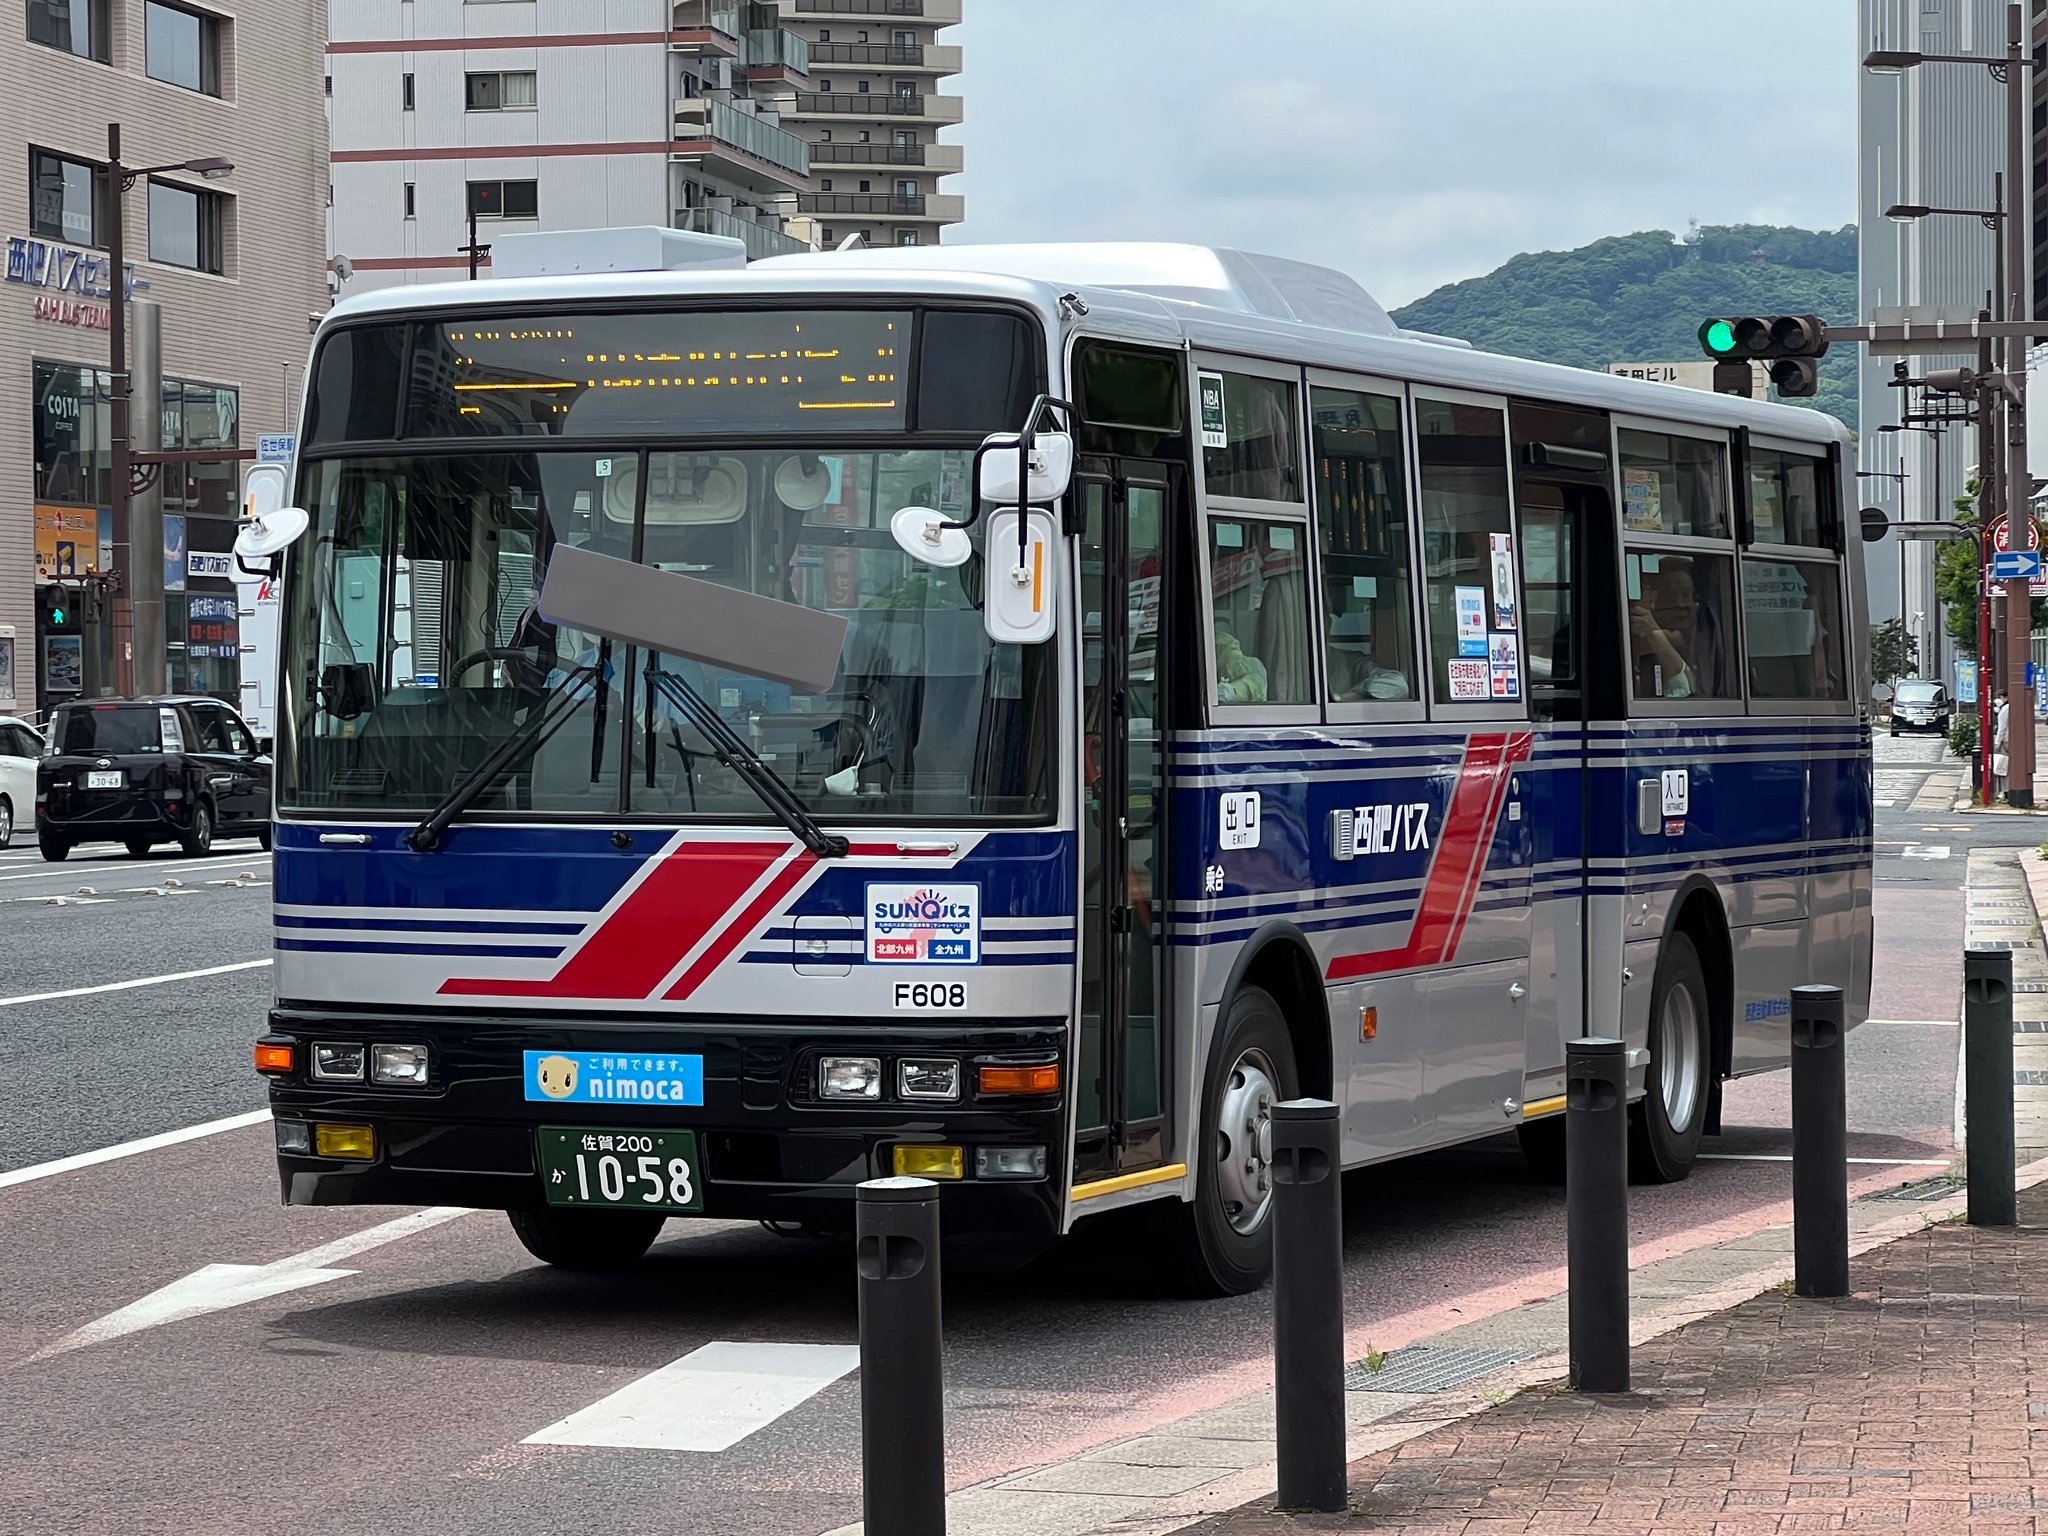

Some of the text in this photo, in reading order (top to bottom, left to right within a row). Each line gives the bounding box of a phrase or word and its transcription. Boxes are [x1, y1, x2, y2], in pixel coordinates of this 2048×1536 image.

[48, 394, 80, 418] COSTA
[1203, 389, 1220, 406] NBA
[1665, 774, 1685, 799] 入口
[1225, 797, 1255, 831] 出口
[1232, 832, 1248, 845] EXIT
[1353, 803, 1429, 855] 西肥バス
[1205, 864, 1225, 892] 乗合
[874, 899, 971, 920] SUNQパス
[877, 944, 915, 955] 北部九州
[935, 944, 964, 955] 全九州
[895, 983, 965, 1007] F608
[589, 1057, 684, 1073] ご利用できます。
[589, 1072, 684, 1101] nimoca
[581, 1134, 653, 1153] 佐賀200
[551, 1154, 693, 1204] か 10-58
